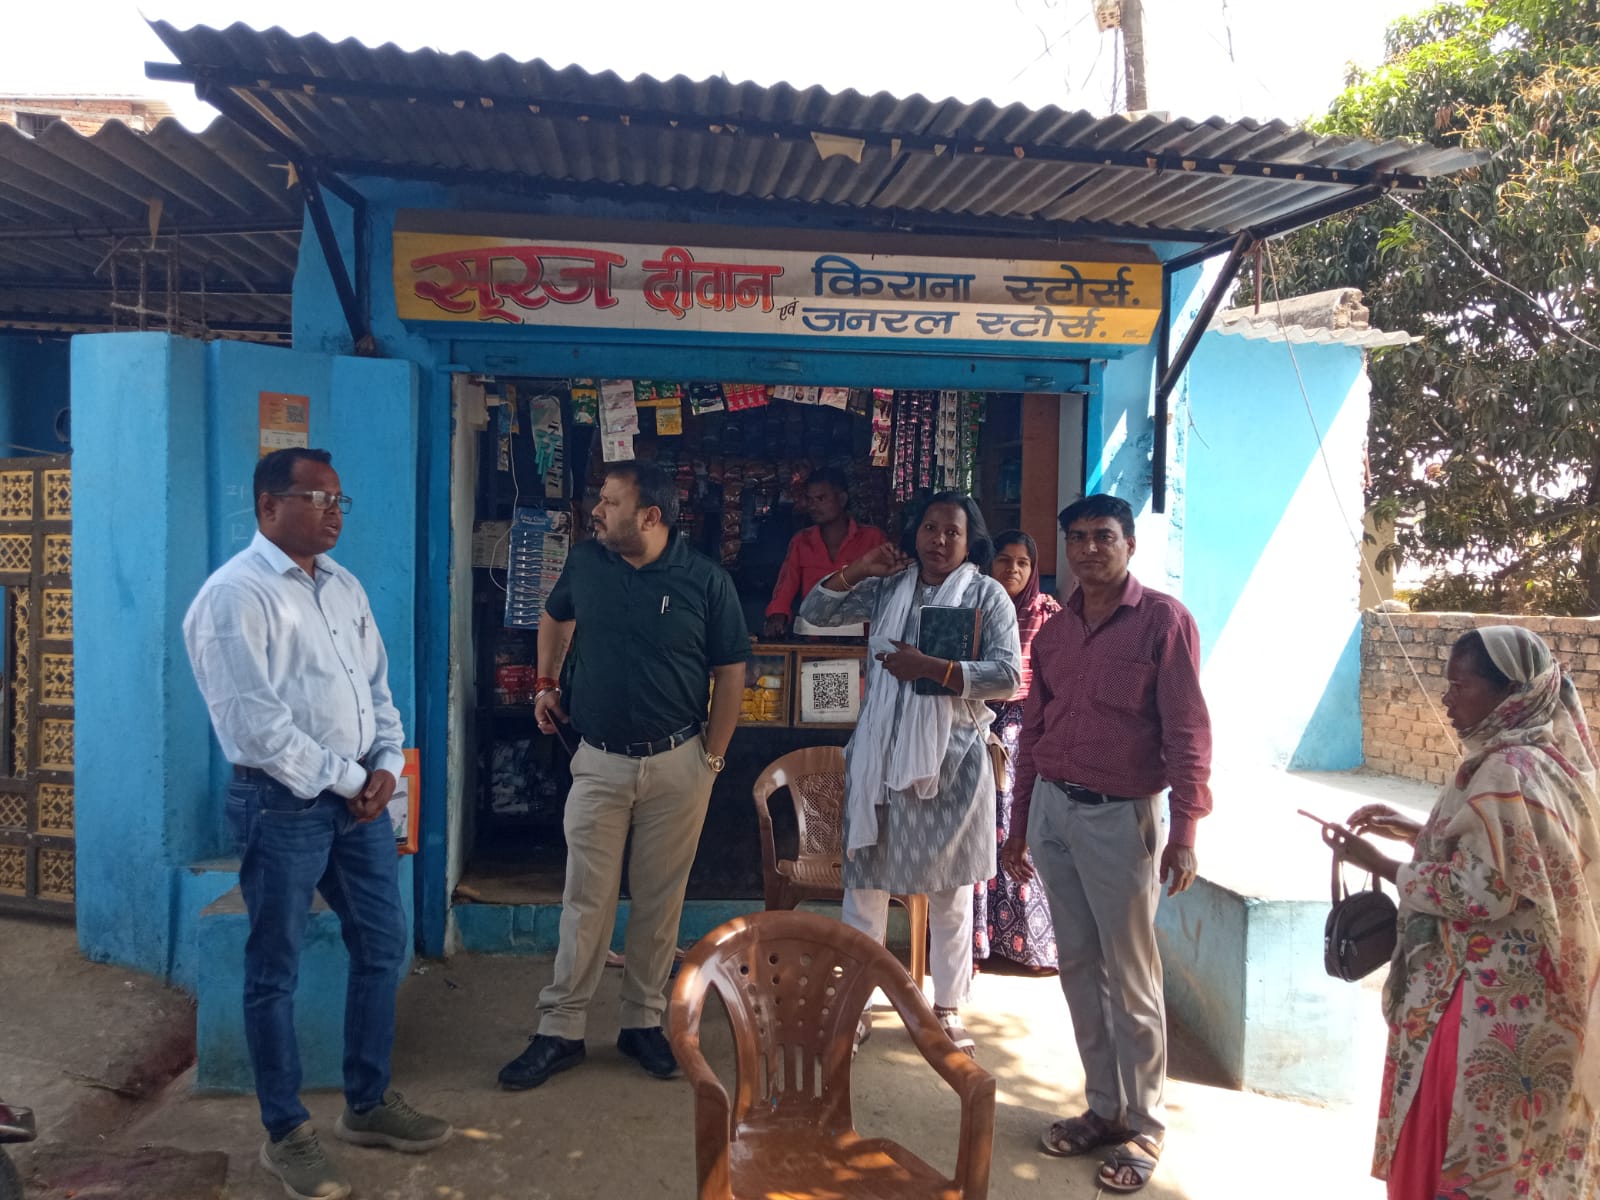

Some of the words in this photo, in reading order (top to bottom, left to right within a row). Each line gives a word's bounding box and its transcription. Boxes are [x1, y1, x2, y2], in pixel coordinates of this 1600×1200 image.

[410, 246, 627, 324] सूरज
[642, 246, 784, 319] दीवान
[811, 255, 976, 301] किराना
[802, 307, 960, 334] जनरल
